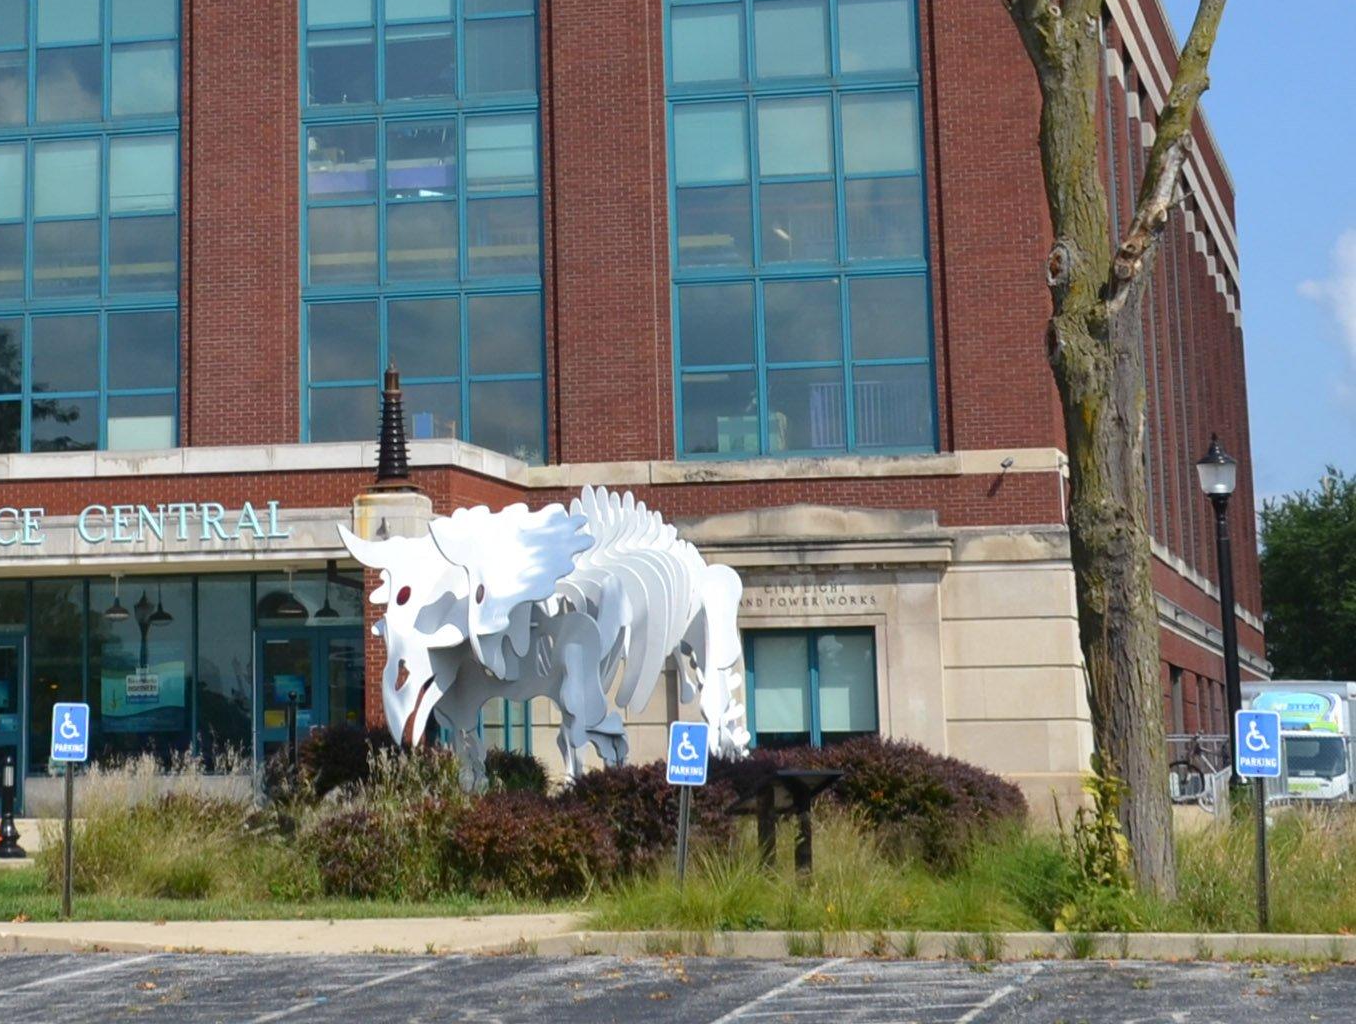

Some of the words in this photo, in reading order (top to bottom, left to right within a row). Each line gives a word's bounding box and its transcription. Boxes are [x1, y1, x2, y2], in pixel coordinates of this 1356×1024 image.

[77, 500, 293, 545] CENTRAL
[764, 584, 796, 594] CITY
[804, 582, 847, 593] LIGHT
[770, 597, 819, 607] POWER
[826, 595, 877, 606] WORKS
[54, 743, 84, 753] PARKING
[1240, 756, 1277, 768] PARKING
[670, 765, 704, 776] PARKING
